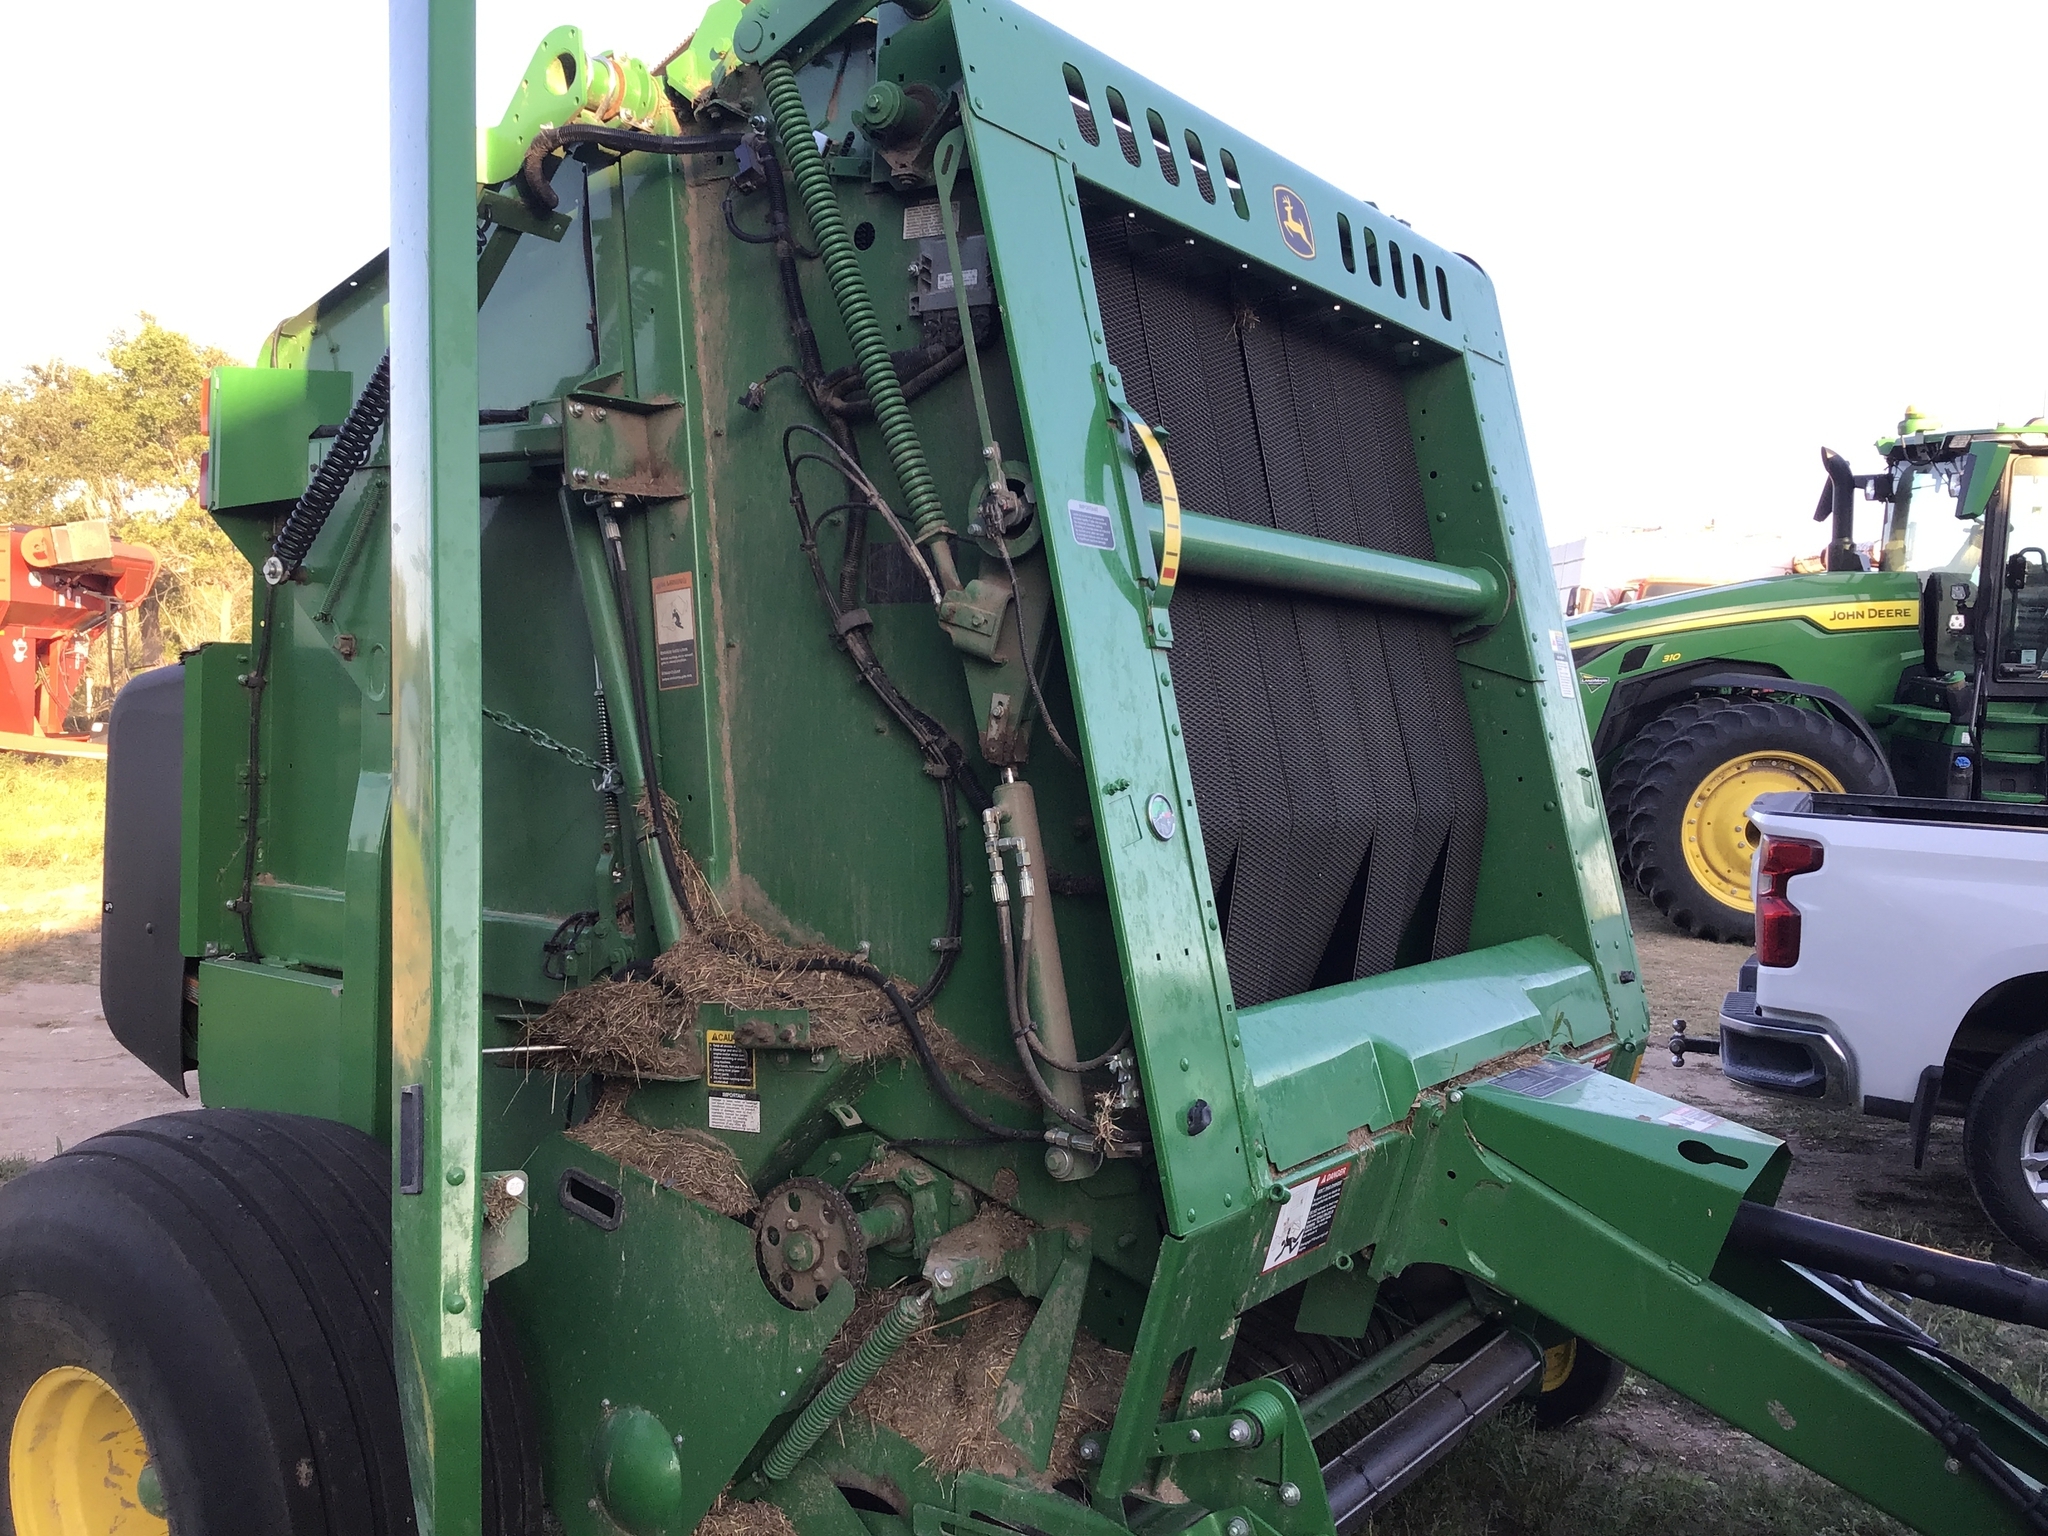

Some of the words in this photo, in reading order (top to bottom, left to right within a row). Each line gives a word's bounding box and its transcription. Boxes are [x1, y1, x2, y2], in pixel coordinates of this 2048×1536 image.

[1829, 610, 1865, 621] JOHN
[1867, 608, 1911, 619] DEERE
[1662, 652, 1681, 663] 310
